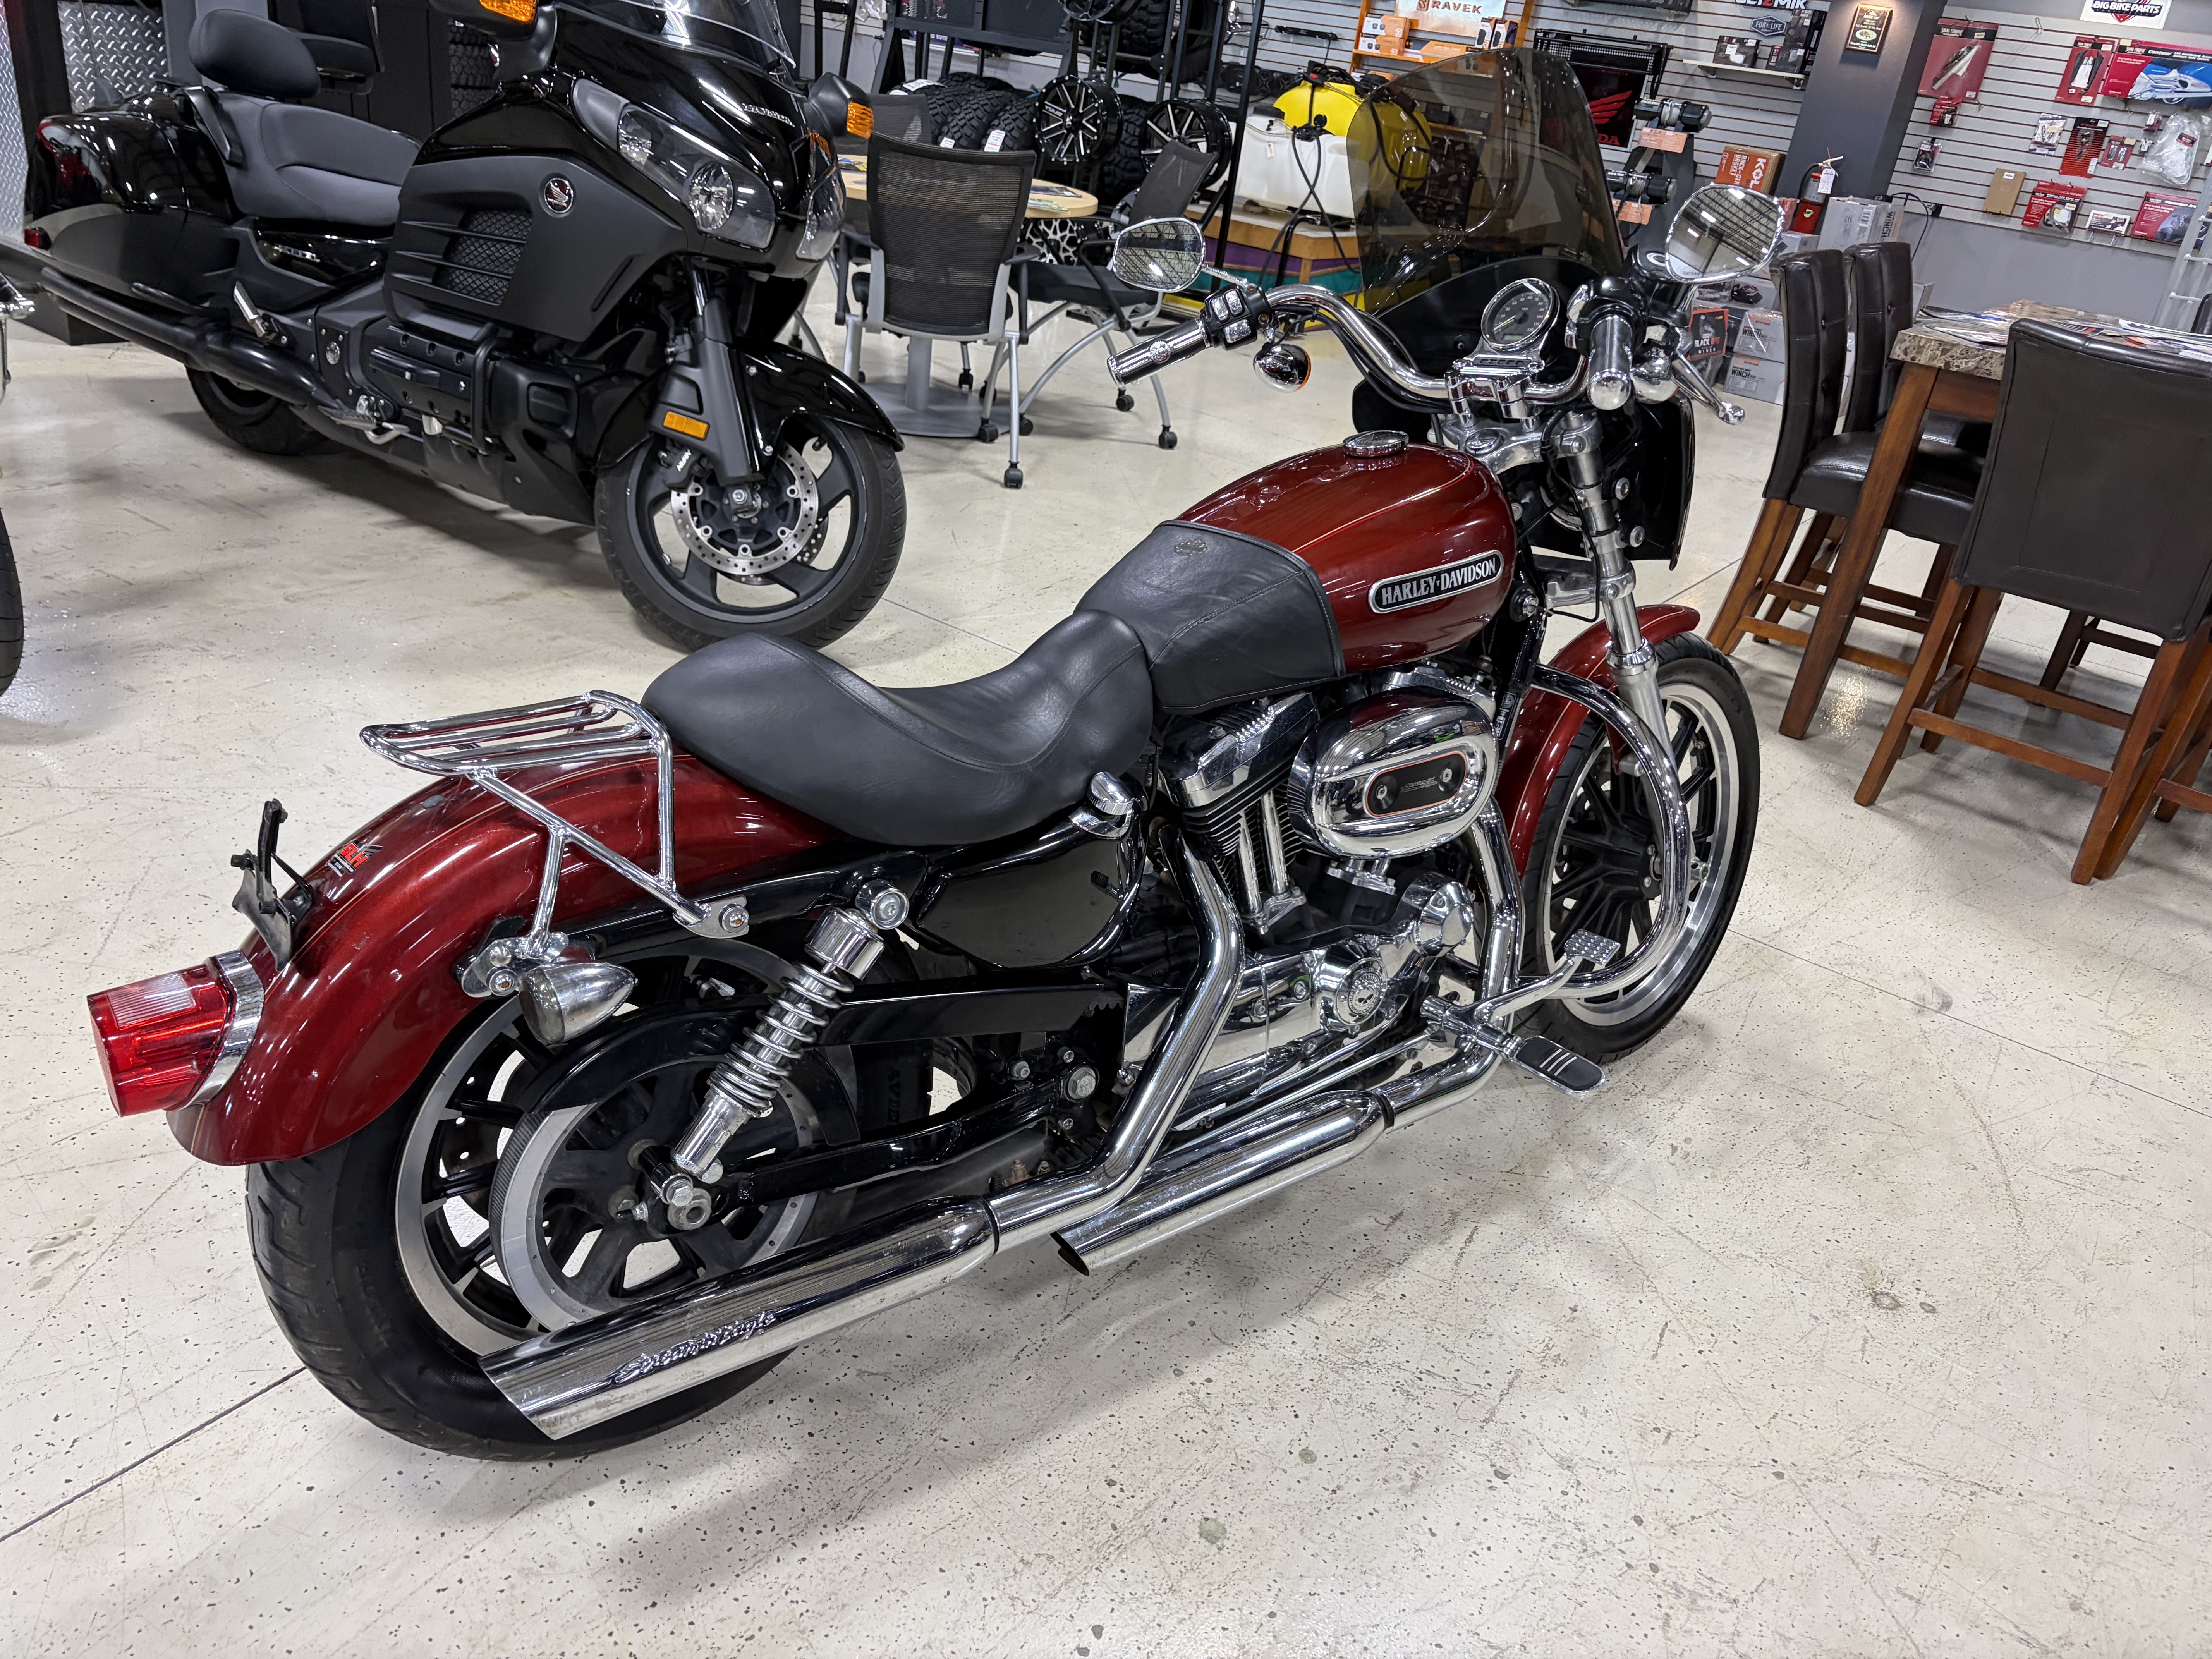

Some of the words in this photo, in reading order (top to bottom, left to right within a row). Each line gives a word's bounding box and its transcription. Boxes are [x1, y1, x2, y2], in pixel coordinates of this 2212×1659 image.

[1431, 0, 1482, 14] RAVEK
[2094, 0, 2109, 9] BIG
[2110, 2, 2131, 11] BIKE
[2131, 4, 2160, 14] PARTS
[1733, 155, 1747, 185] RACK-GEA
[1749, 158, 1767, 188] KOL
[1881, 212, 1894, 238] WINCH
[1731, 369, 1750, 379] WINCH
[1382, 557, 1496, 605] HARLEY-DAVIDSON
